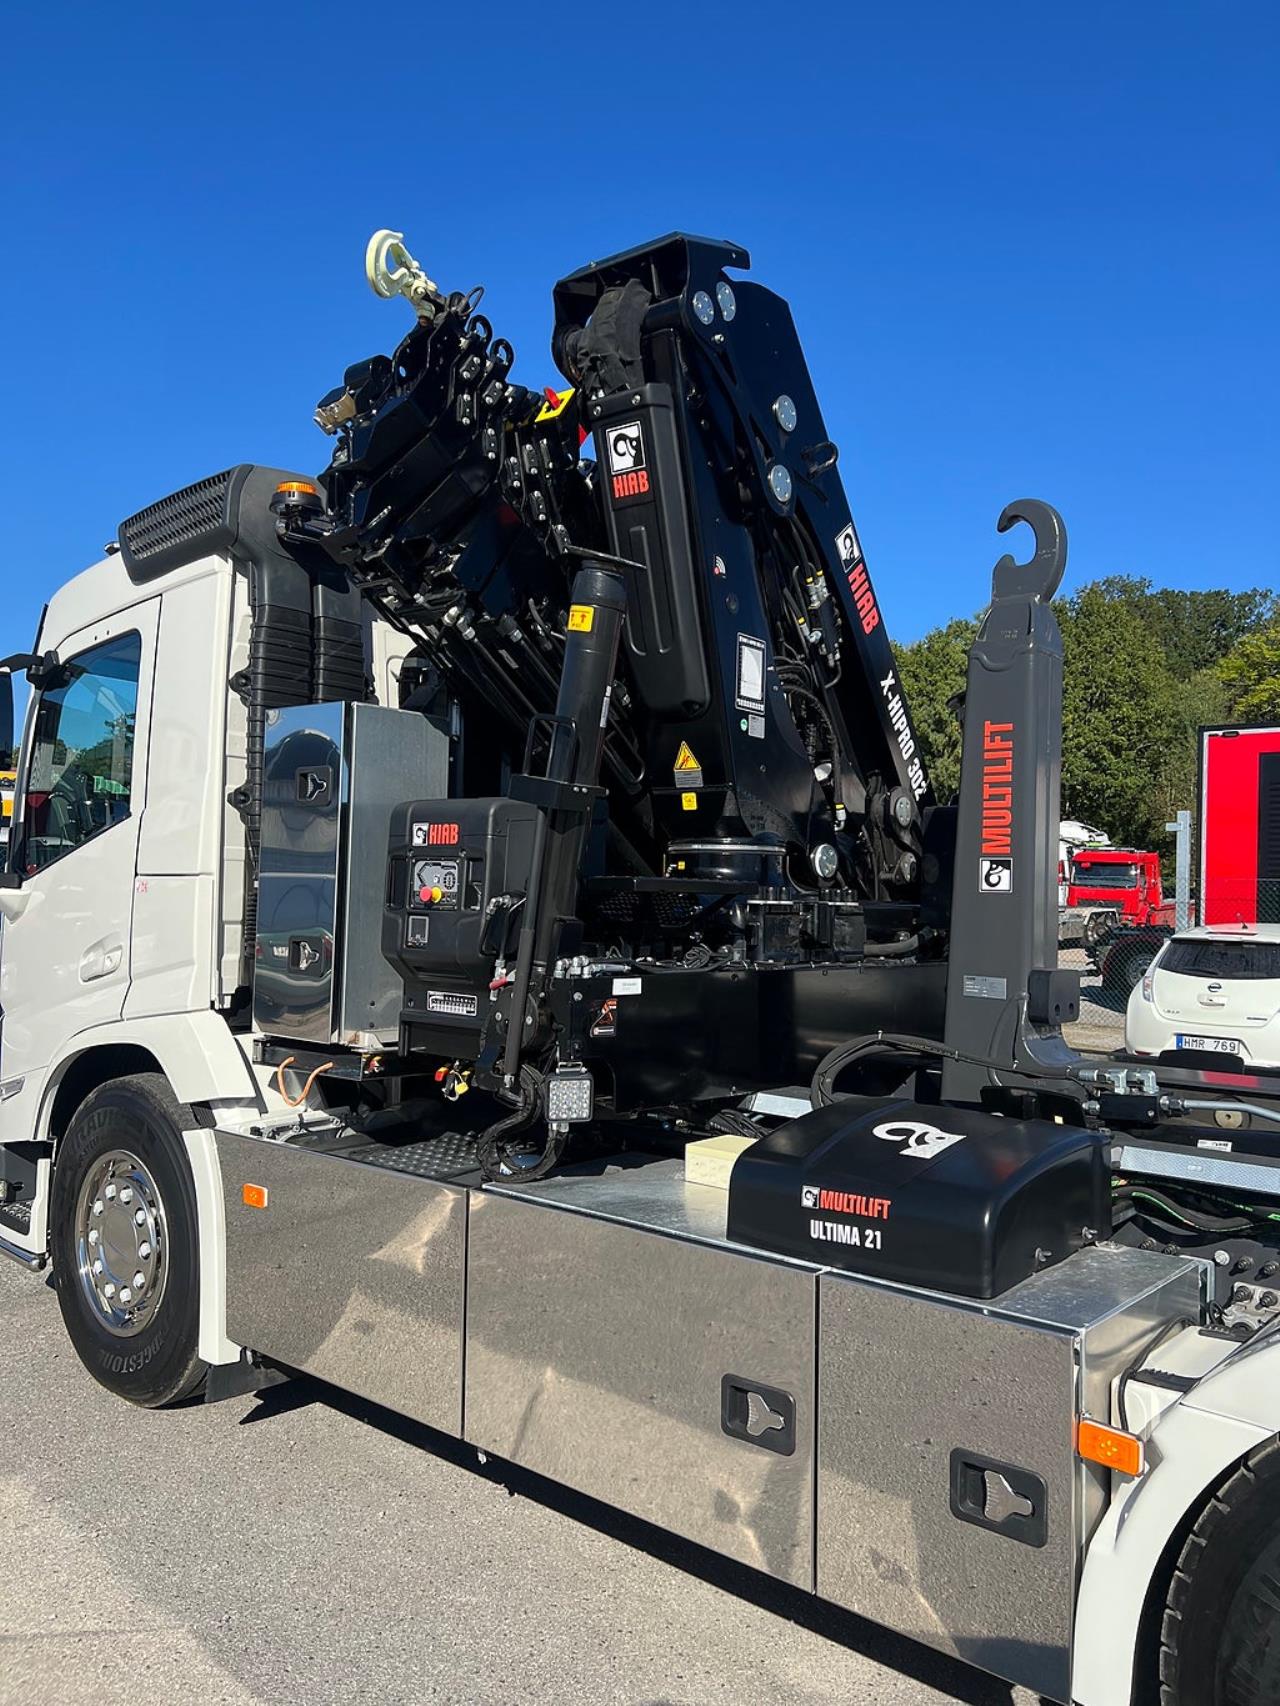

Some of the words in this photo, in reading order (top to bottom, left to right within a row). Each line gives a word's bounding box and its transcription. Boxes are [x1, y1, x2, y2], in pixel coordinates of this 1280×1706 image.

[612, 470, 649, 498] HIAB
[848, 563, 879, 635] HIAB
[880, 669, 915, 760] X-HIPRO
[982, 720, 1013, 854] MULTILIFT
[428, 823, 460, 845] HIAB
[1184, 1037, 1206, 1049] HMR
[1213, 1040, 1236, 1052] 769
[820, 1189, 892, 1219] MULTILIFT
[810, 1219, 861, 1247] ULTIMA
[864, 1229, 882, 1250] 21
